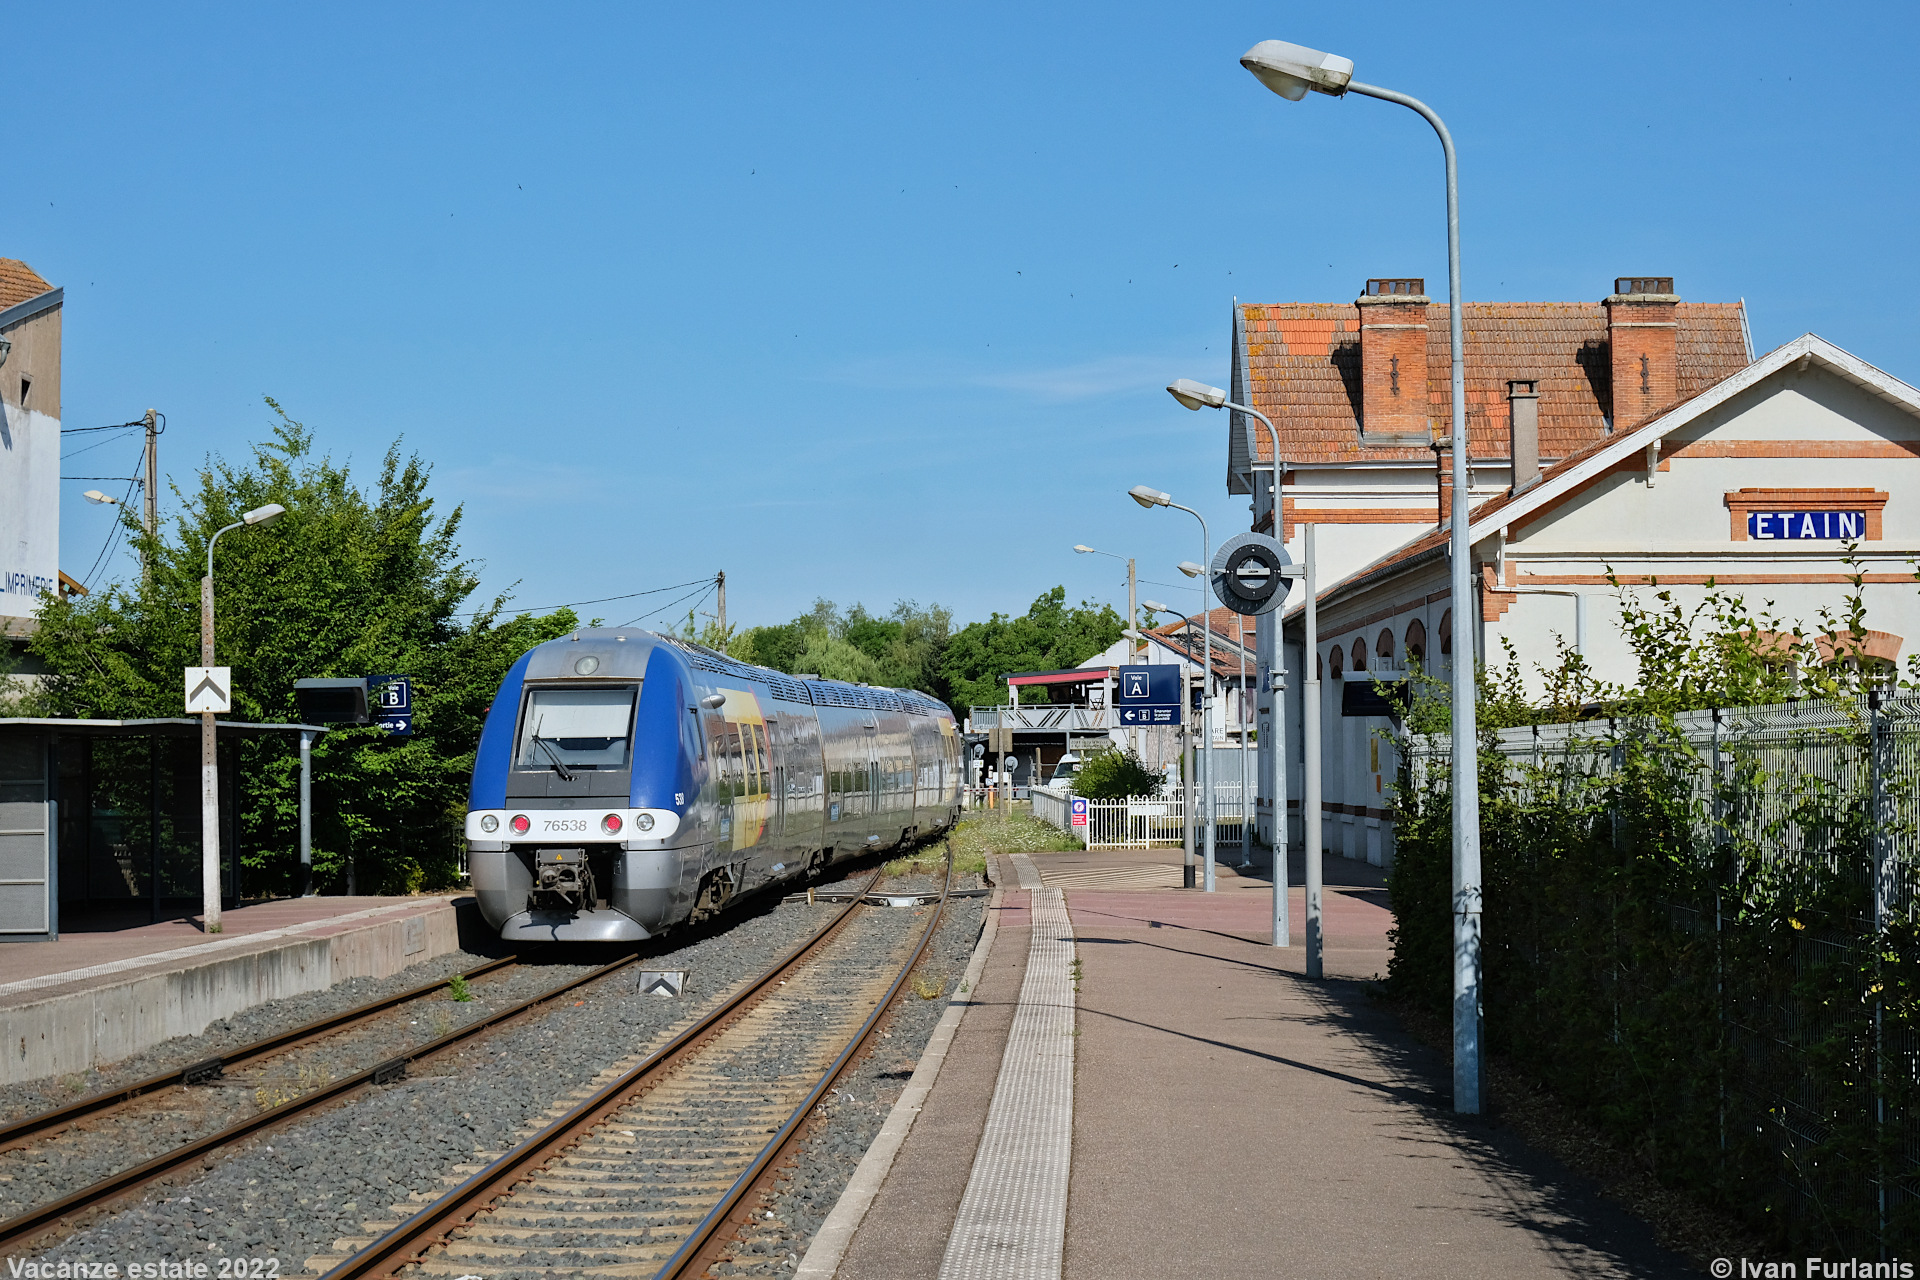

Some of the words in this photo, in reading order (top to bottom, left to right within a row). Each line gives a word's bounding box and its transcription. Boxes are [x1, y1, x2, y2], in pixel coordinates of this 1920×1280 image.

[1756, 513, 1857, 538] ETAIN
[1131, 682, 1143, 695] A
[389, 692, 399, 705] B
[674, 792, 685, 806] 538
[543, 820, 587, 832] 76538
